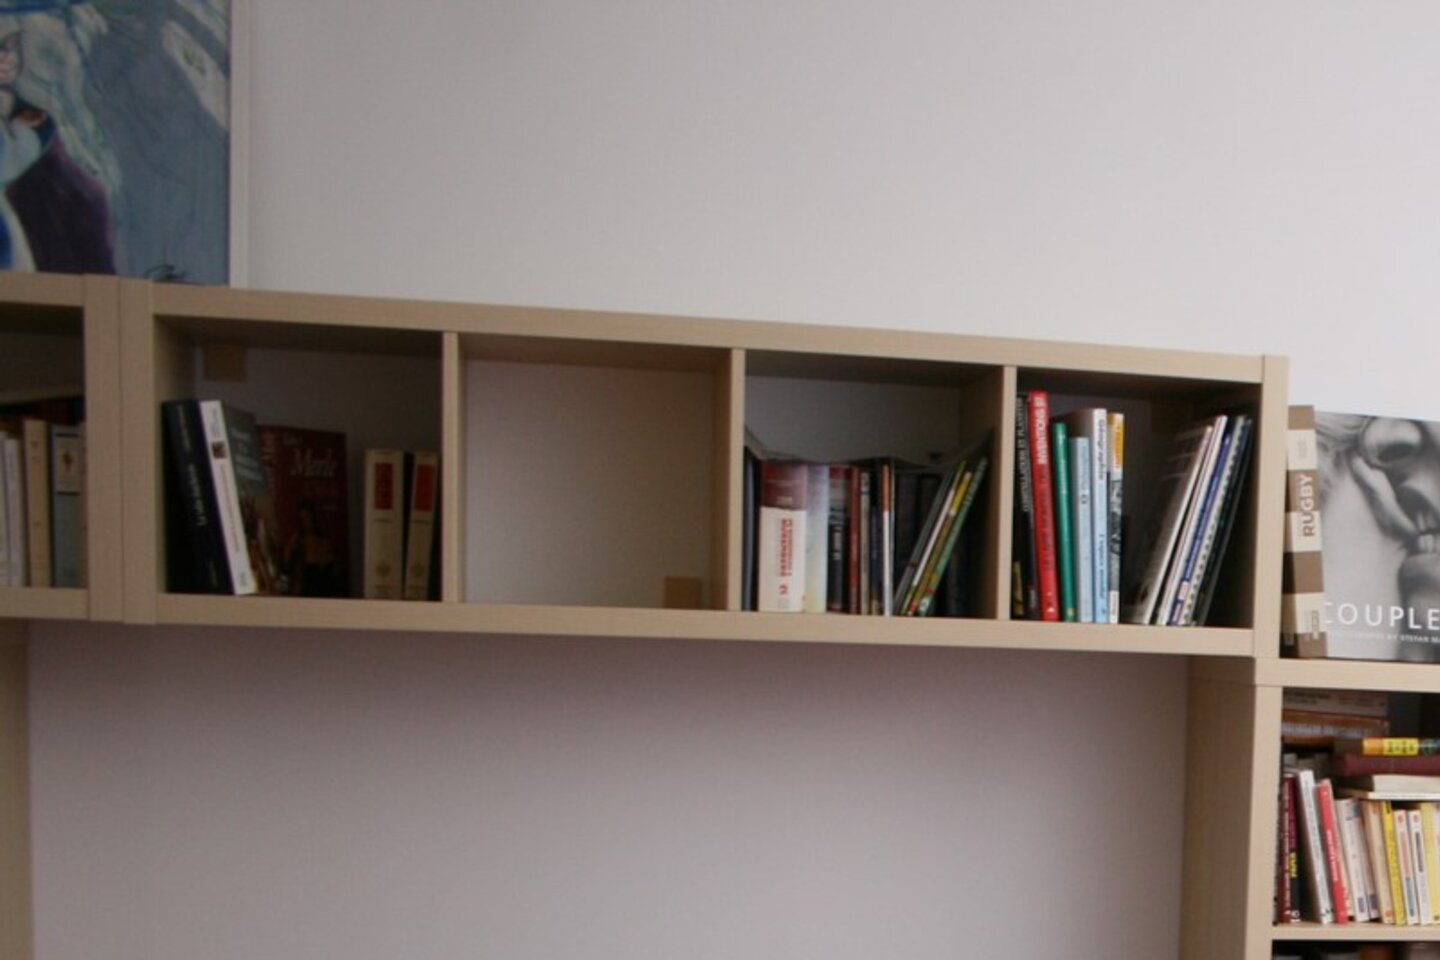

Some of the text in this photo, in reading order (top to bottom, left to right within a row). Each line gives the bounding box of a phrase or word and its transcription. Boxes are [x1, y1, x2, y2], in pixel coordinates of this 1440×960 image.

[1097, 418, 1108, 481] Géographie
[1297, 473, 1317, 538] RUGBY
[1400, 634, 1429, 643] STEFAN
